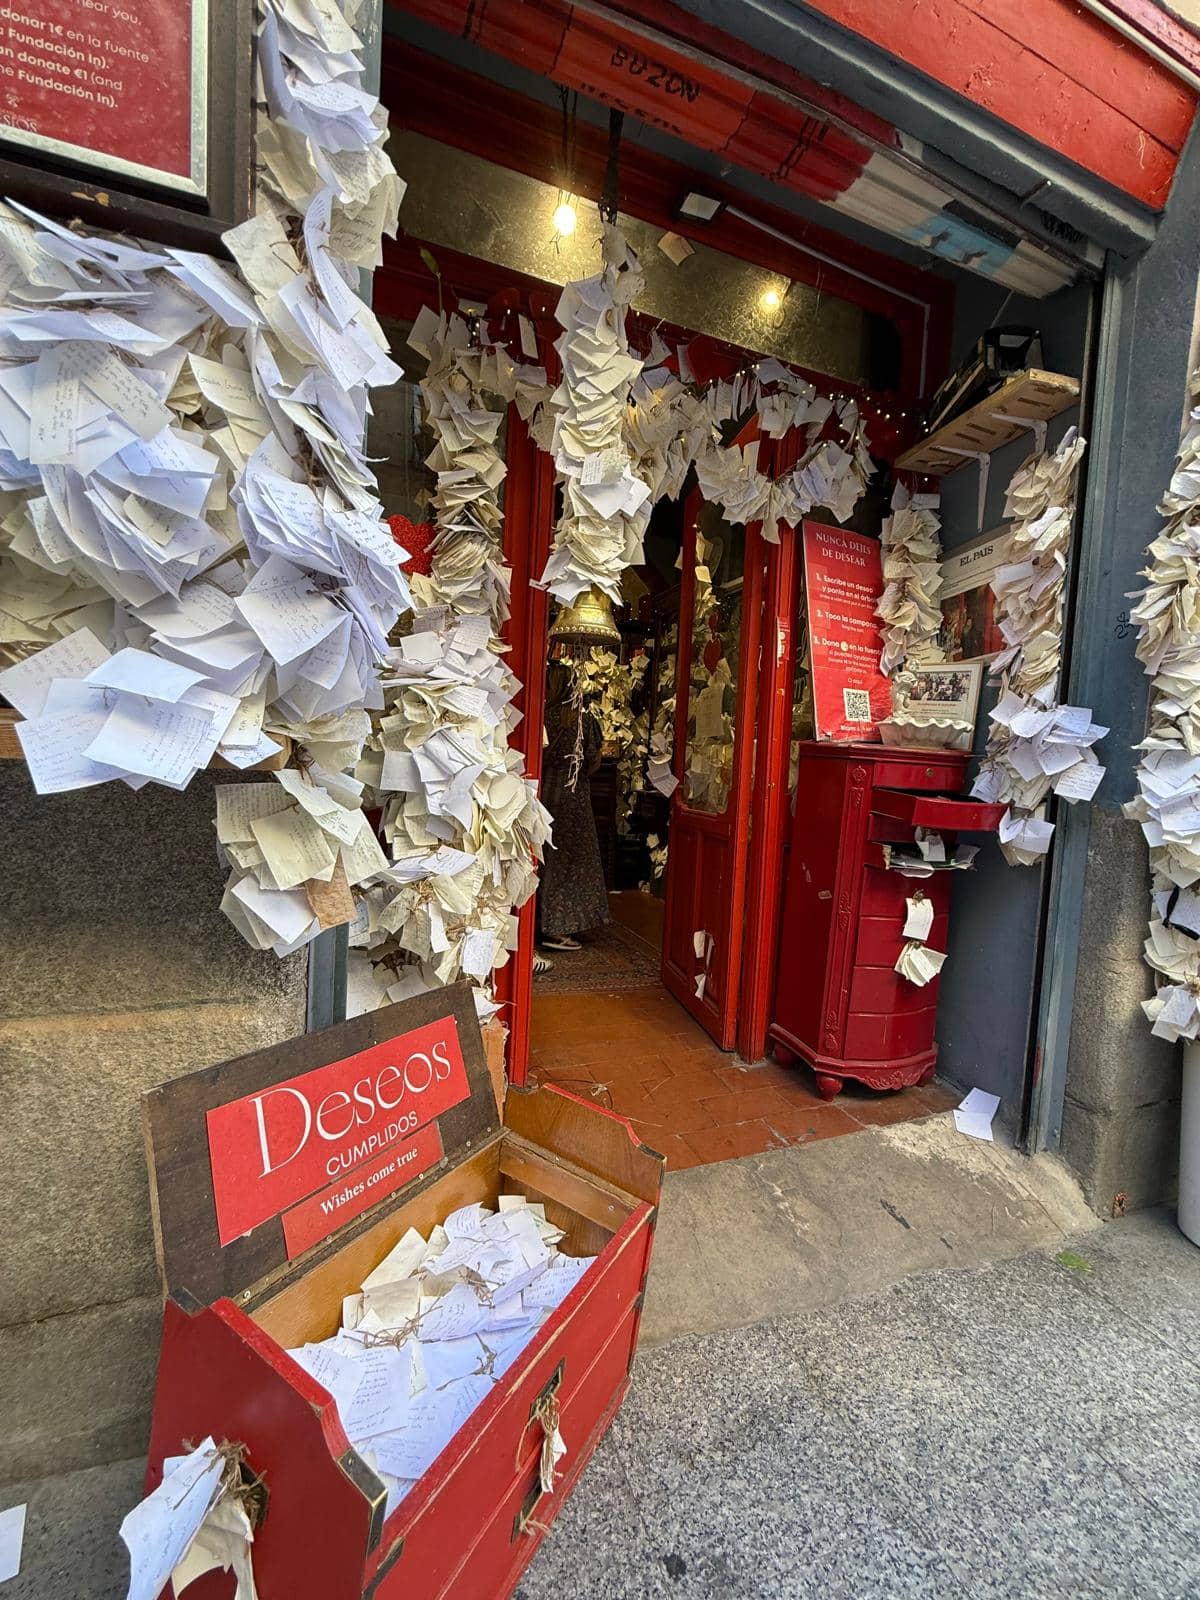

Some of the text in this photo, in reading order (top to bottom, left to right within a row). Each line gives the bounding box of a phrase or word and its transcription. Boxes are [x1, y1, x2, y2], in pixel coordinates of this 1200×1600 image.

[112, 8, 142, 25] you.
[0, 8, 150, 63] donar 1€ en la fuente
[8, 28, 85, 61] Fundación
[88, 54, 111, 70] In).
[17, 52, 71, 75] donate
[73, 68, 88, 80] €1
[91, 72, 123, 91] (and
[18, 70, 94, 101] Fundación
[97, 92, 119, 108] In).
[816, 532, 847, 548] NUNCA
[822, 548, 866, 567] DE DESEAR
[960, 555, 972, 567] EL
[823, 575, 846, 587] Escribe
[825, 611, 841, 621] Toca
[822, 638, 840, 648] Dona
[325, 1110, 419, 1177] CUMPLIDOS
[320, 1146, 418, 1216] Wishes come true
